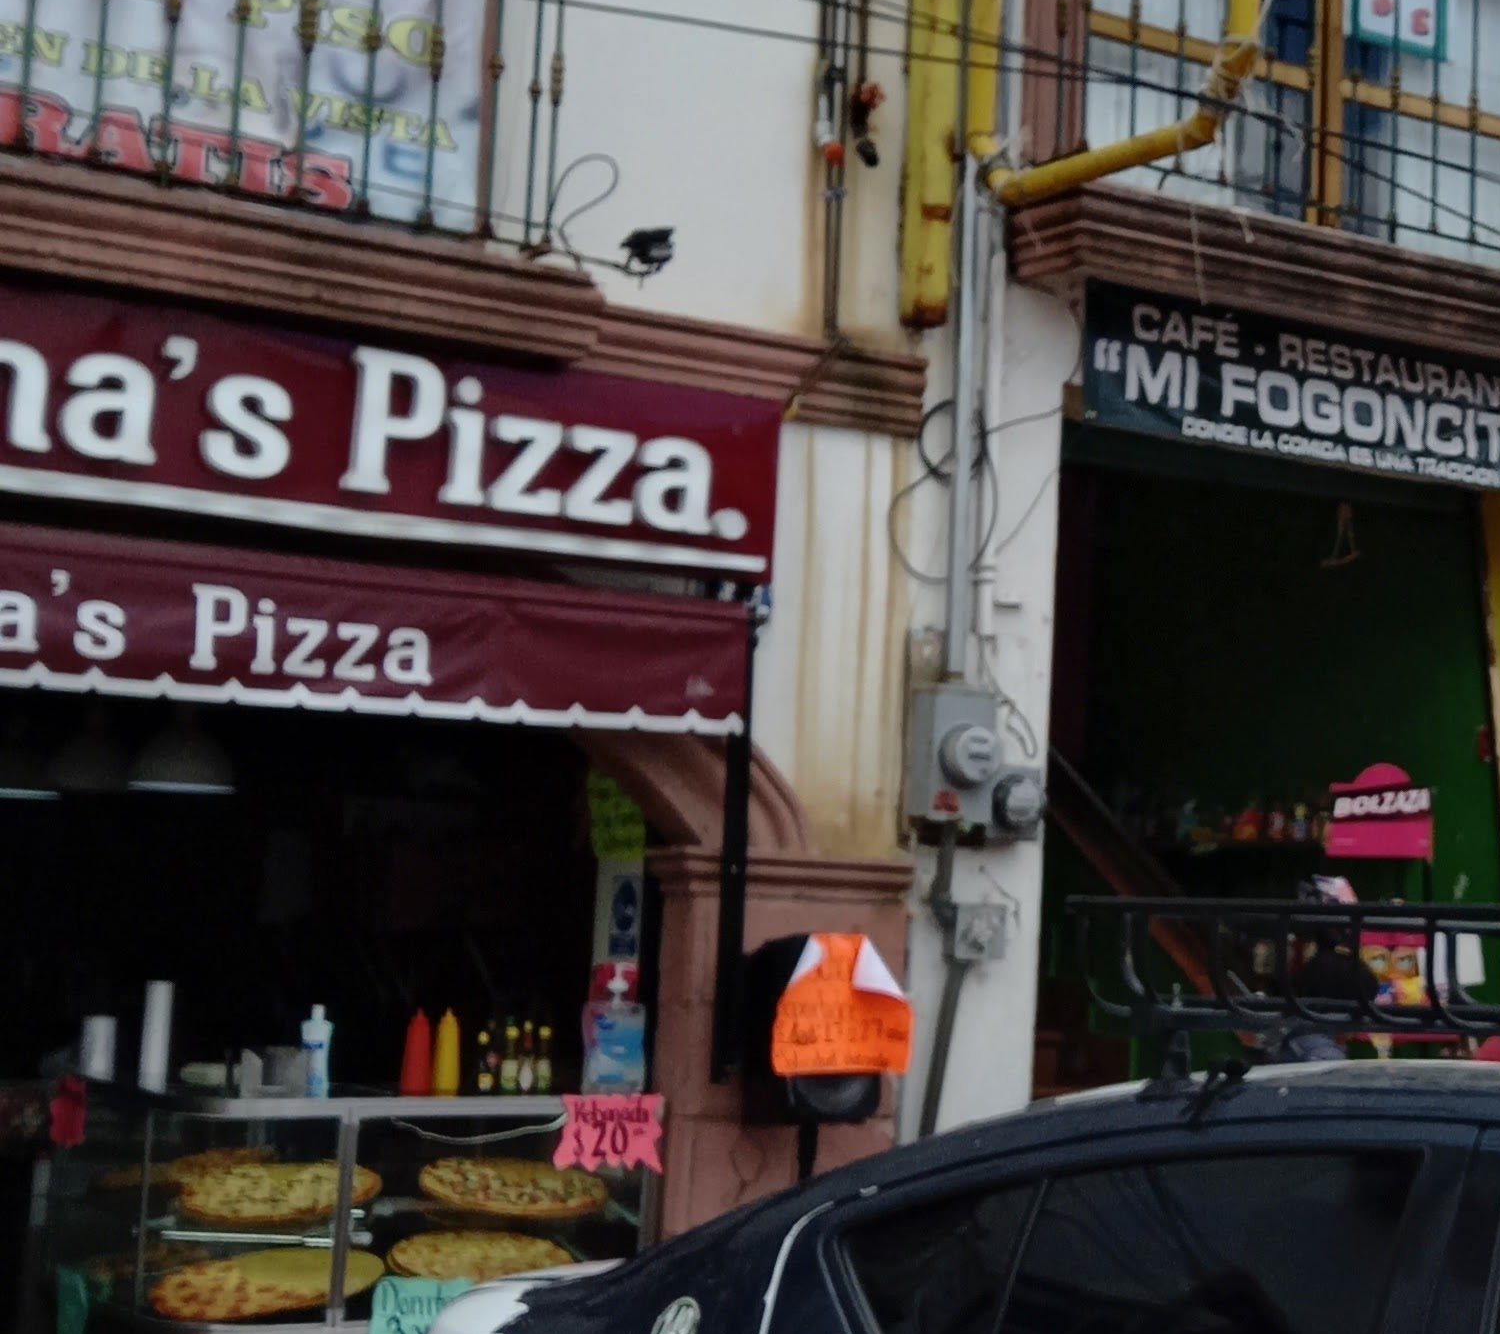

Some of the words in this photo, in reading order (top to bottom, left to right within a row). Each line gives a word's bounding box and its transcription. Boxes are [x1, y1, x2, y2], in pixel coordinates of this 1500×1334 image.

[191, 62, 270, 113] LA
[287, 86, 458, 153] VISTA
[1131, 303, 1241, 359] CAFÉ
[1250, 429, 1276, 451] LA
[189, 582, 434, 688] Pizza
